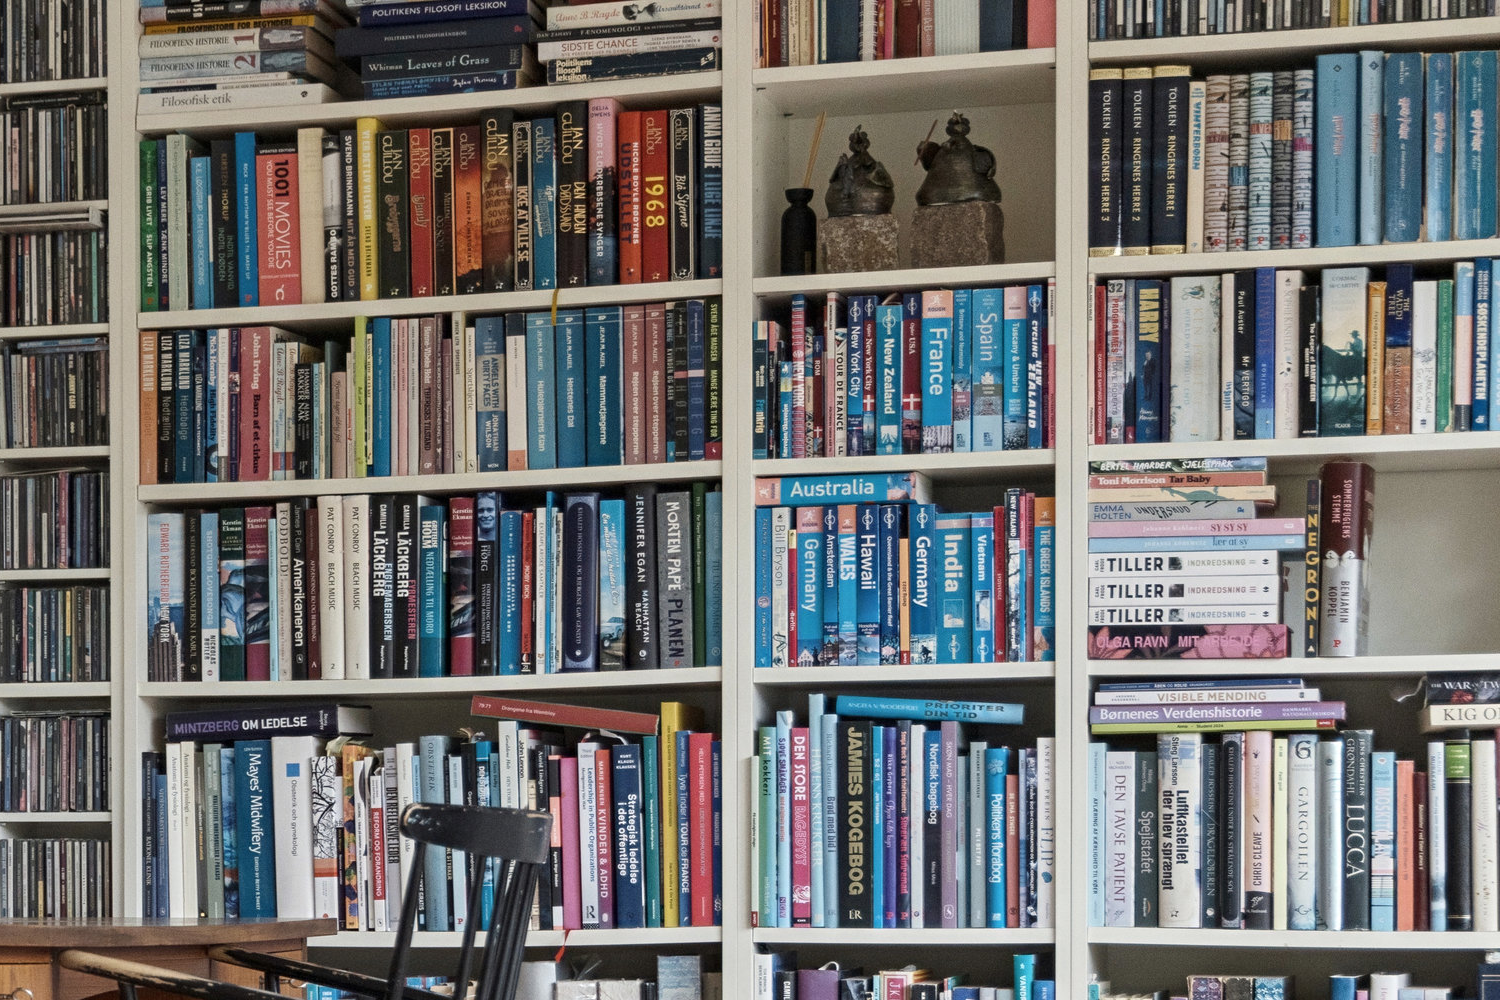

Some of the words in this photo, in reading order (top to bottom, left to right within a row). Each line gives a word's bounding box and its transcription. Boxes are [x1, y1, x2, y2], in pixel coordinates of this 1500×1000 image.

[372, 7, 421, 16] POLITIKENS
[424, 4, 462, 14] FILOSOFI
[465, 0, 507, 11] LEKSIKON
[368, 64, 402, 72] Whitman
[408, 58, 443, 70] Leaves
[446, 57, 456, 68] of
[460, 54, 490, 68] Grass
[1102, 90, 1110, 128] TOLKIEN
[1168, 86, 1178, 125] TOLKIEN
[1102, 138, 1110, 182] RINGENES
[1167, 134, 1176, 179] RINGENES
[274, 160, 290, 198] 1001
[1167, 181, 1175, 208] HERRE
[646, 176, 664, 228] 1968
[1101, 185, 1109, 212] HERRE
[276, 202, 291, 269] MOVIES
[1139, 288, 1160, 343] HARRY
[251, 333, 262, 358] John
[851, 326, 860, 348] New
[884, 338, 895, 365] New
[974, 312, 997, 362] Spain
[1475, 302, 1488, 400] SØSKENDEPLANETEN
[250, 360, 262, 390] Irving
[482, 360, 492, 382] DIRTY
[490, 357, 500, 388] ANGELS
[851, 352, 860, 374] York
[929, 328, 947, 396] France
[252, 394, 262, 416] Barn
[482, 384, 492, 407] FACES
[492, 390, 500, 408] WITH
[848, 376, 860, 398] City
[884, 368, 896, 414] Zealand
[252, 420, 262, 430] af
[252, 432, 261, 442] et
[252, 444, 262, 474] cirkus
[790, 478, 874, 498] Australia
[1098, 477, 1118, 486] Toni
[1120, 476, 1166, 484] Morrison
[1169, 476, 1184, 484] Tar
[1186, 475, 1212, 486] Baby
[636, 494, 645, 548] JENNIFER
[1094, 504, 1124, 512] EMMA
[1094, 512, 1132, 520] HOLTEN
[1332, 494, 1342, 523] STEMME
[1344, 479, 1352, 538] SOMMERFUGLENS
[279, 510, 288, 578] FODBOLD!
[666, 502, 681, 554] MORTEN
[373, 531, 387, 597] LÄCKBERG
[636, 552, 646, 583] EGAN
[667, 558, 682, 590] PAPE
[800, 538, 818, 612] Germany
[826, 534, 834, 588] Amsterdam
[839, 536, 856, 581] WALES
[860, 535, 876, 590] Hawaii
[913, 536, 930, 608] Germany
[944, 534, 963, 592] India
[978, 534, 986, 582] Vietnam
[1107, 558, 1164, 572] TILLER
[1187, 558, 1246, 567] INDKREDSNING
[1305, 513, 1320, 639] NEGRONI
[384, 563, 393, 641] ENGLEMAGERSKEN
[642, 590, 650, 644] MANHATTAN
[1328, 586, 1338, 618] KOPPEL
[1340, 580, 1350, 624] BENJAMIN
[668, 598, 684, 658] PLANEN
[1100, 709, 1159, 720] Børnenes
[1162, 706, 1262, 719] Verdenshistorie
[1158, 692, 1204, 702] VISIBLE
[1208, 692, 1266, 701] MENDING
[1444, 708, 1476, 721] KIG
[174, 720, 239, 734] MINTZBERG
[242, 718, 259, 730] OM
[261, 716, 308, 729] LEDELSE
[794, 736, 806, 761] DEN
[848, 727, 862, 796] JAMIES
[928, 744, 938, 780] Nordisk
[1170, 736, 1180, 756] Stieg
[250, 754, 262, 793] Mayes'
[586, 768, 595, 804] Leadership
[794, 764, 806, 800] STORE
[1114, 775, 1126, 801] DEN
[1171, 758, 1180, 786] Larsson
[386, 787, 397, 800] DEN
[927, 782, 938, 825] bagebog
[1162, 790, 1174, 809] der
[250, 795, 262, 854] Midwifery
[387, 803, 398, 844] REFLEKSIVE
[598, 809, 608, 856] KVINDER
[618, 808, 627, 825] det
[628, 794, 638, 846] Strategisk
[992, 794, 1003, 840] Politikens
[1114, 808, 1126, 846] TAVSE
[1163, 813, 1174, 838] blev
[1176, 790, 1190, 864] Luftkastellet
[1298, 786, 1309, 881] GARGOILEN
[388, 846, 399, 864] LEDER
[617, 827, 628, 876] offentlige
[795, 806, 806, 866] BAGEDYST
[848, 801, 863, 896] KOGEBOG
[1138, 811, 1154, 874] Spejlstafet
[1252, 832, 1262, 860] CLEAVE
[1346, 804, 1365, 878] LUCCA
[588, 836, 596, 882] Organizations
[629, 848, 638, 884] ledelse
[990, 842, 1003, 883] florabog
[1114, 852, 1126, 904] PATIENT
[1161, 842, 1174, 890] sprængt
[1252, 862, 1262, 886] CHRIS
[600, 868, 609, 898] ADHD
